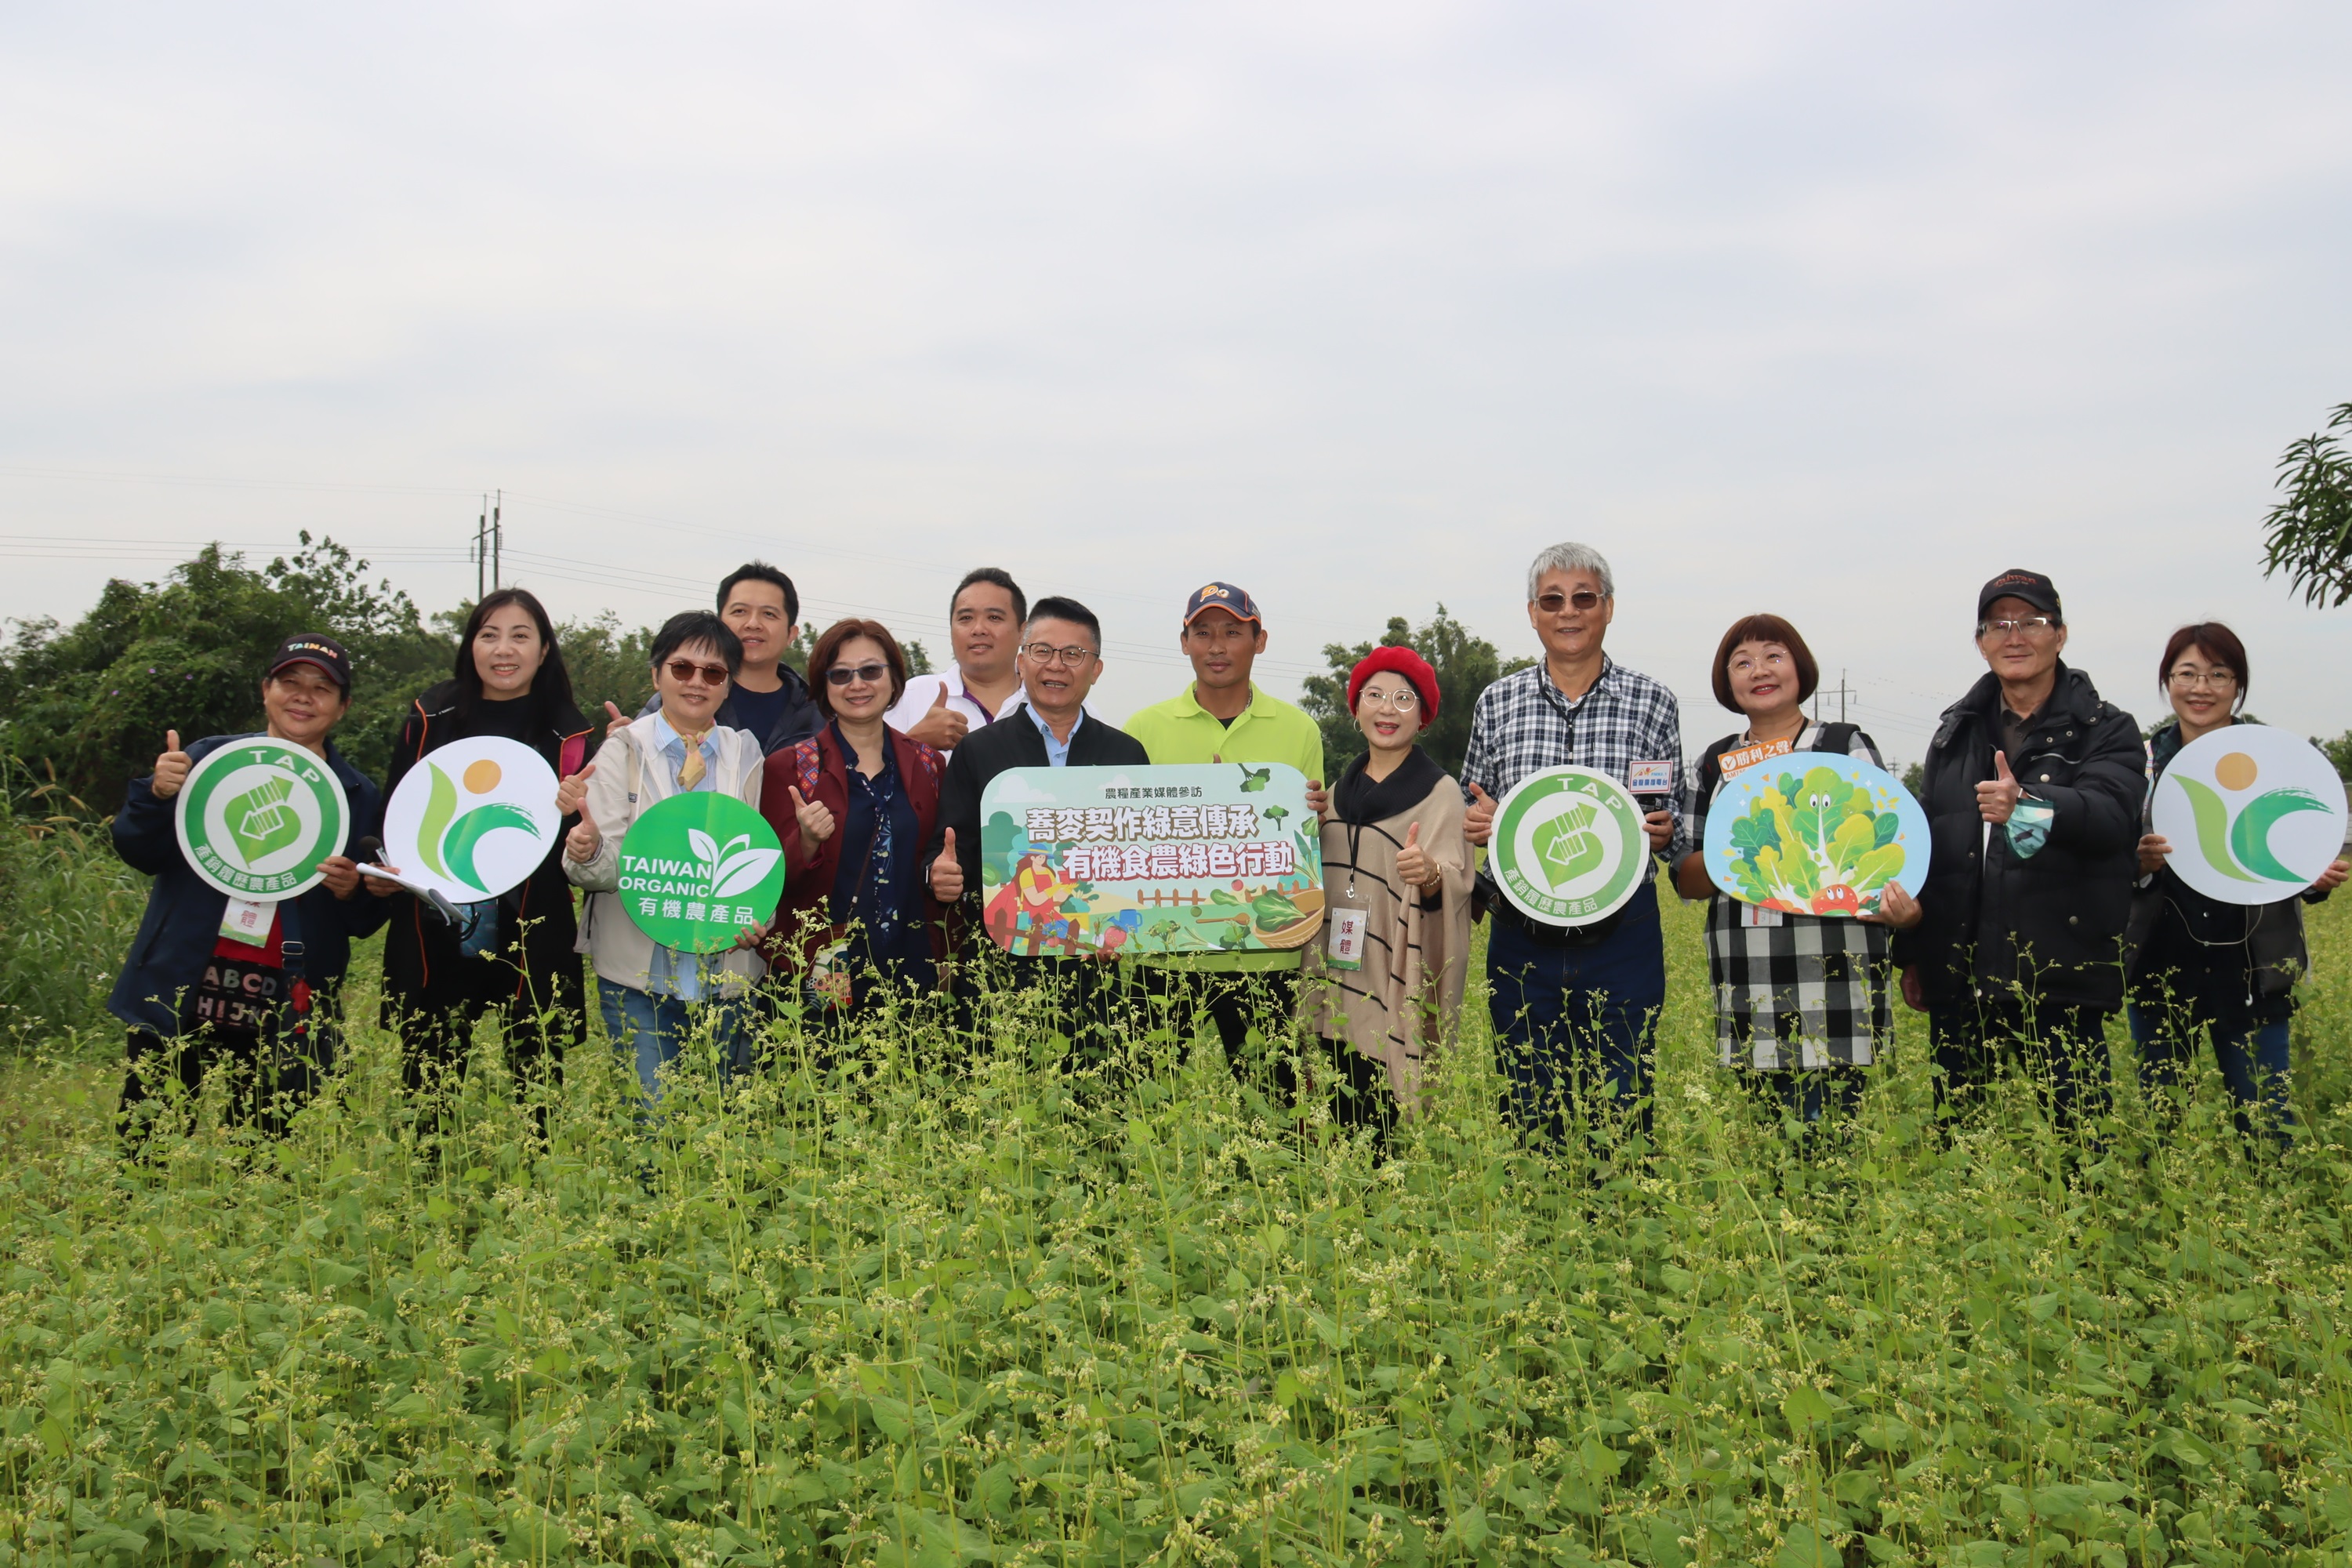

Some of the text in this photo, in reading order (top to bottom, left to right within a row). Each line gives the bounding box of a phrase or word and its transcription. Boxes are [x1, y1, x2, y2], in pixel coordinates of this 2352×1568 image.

[287, 642, 338, 659] TAINAN
[249, 750, 321, 783] TAP
[1735, 740, 1790, 767] 勝利之聲
[1105, 786, 1203, 800] 農糧產業媒體參訪
[1556, 777, 1623, 810] TAP
[1025, 804, 1259, 843] 蕎麥契作綠意傳承
[194, 843, 297, 891] 產銷履歷農產品
[622, 855, 713, 880] TAIWAN
[1062, 840, 1295, 880] 有機食農綠色行動
[618, 876, 710, 898] ORGANIC
[1504, 867, 1598, 916] 產銷履歷農產品
[638, 897, 753, 925] 有機農產品
[1339, 920, 1354, 955] 媒體
[203, 965, 278, 996] ABCD
